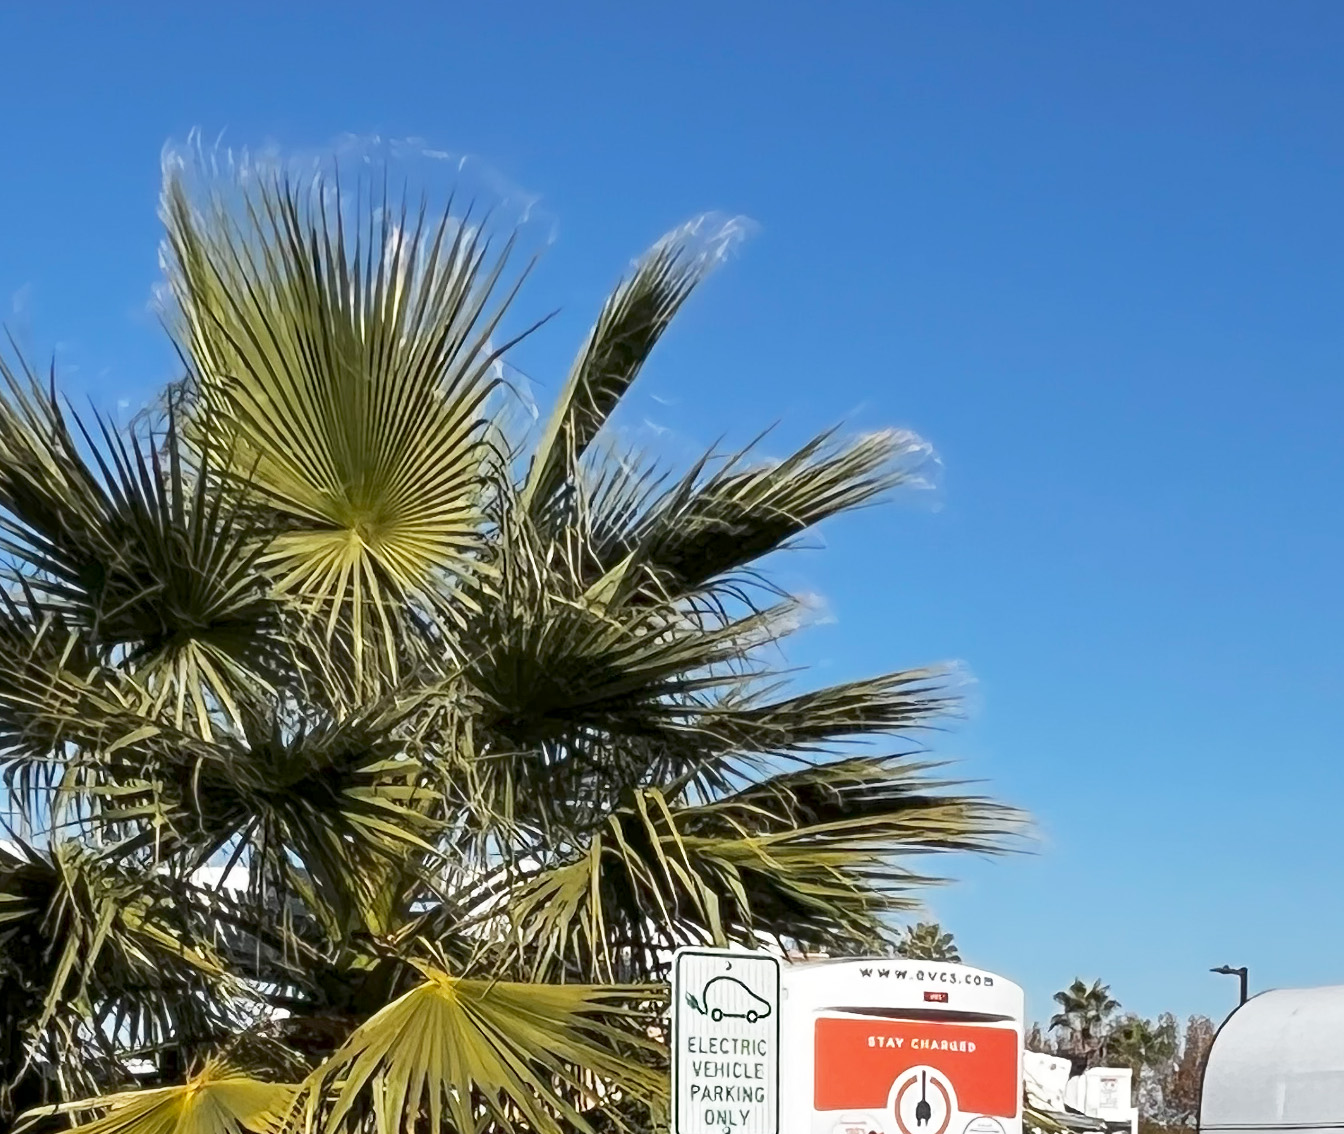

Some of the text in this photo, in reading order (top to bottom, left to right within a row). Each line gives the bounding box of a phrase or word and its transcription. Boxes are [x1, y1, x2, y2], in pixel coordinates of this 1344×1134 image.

[688, 1036, 767, 1056] ELECTRIC
[867, 1035, 905, 1049] STAY
[692, 1060, 764, 1080] VEHICLE
[690, 1084, 765, 1103] PARKING
[704, 1108, 750, 1127] ONLY
